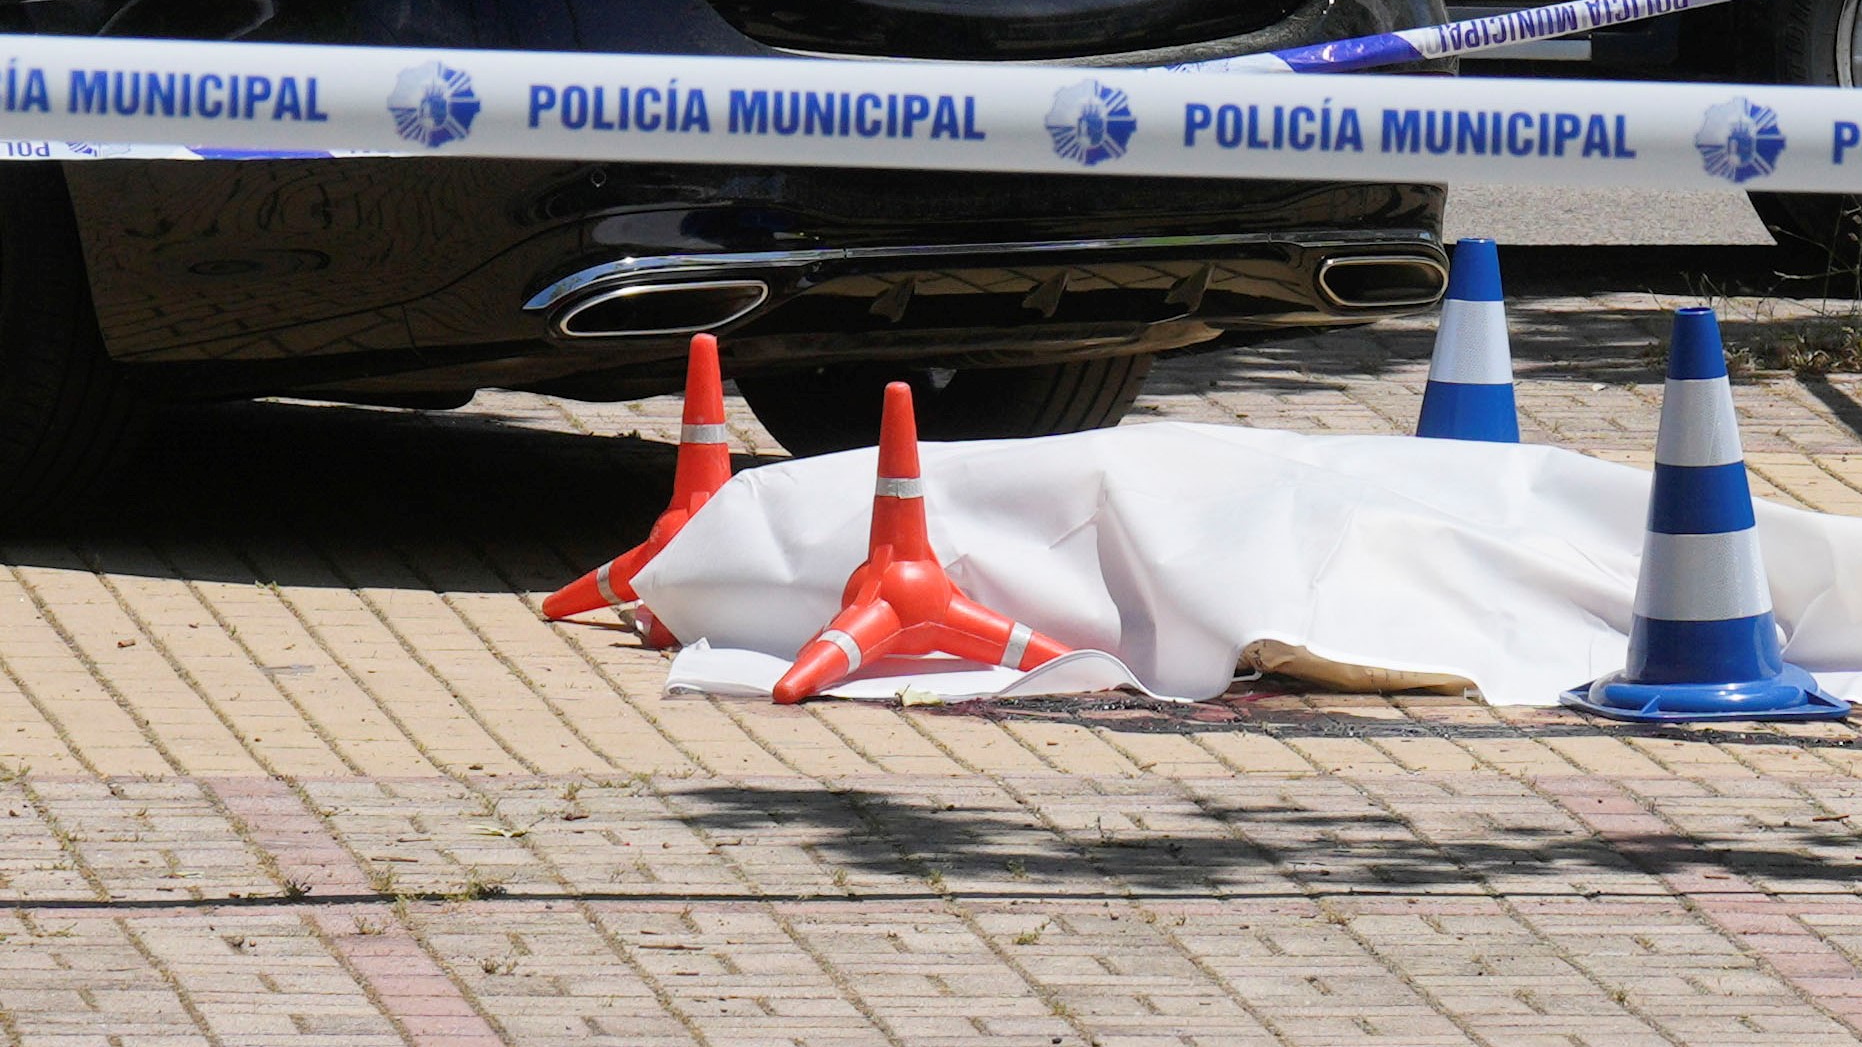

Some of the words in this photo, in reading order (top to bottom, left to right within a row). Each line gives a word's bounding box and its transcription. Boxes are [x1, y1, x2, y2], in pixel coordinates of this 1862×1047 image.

[68, 68, 329, 123] MUNICIPAL
[529, 78, 711, 134] POLICÍA
[728, 88, 986, 142] MUNICIPAL
[1184, 97, 1364, 153] POLICÍA
[1381, 108, 1637, 160] MUNICIPAL
